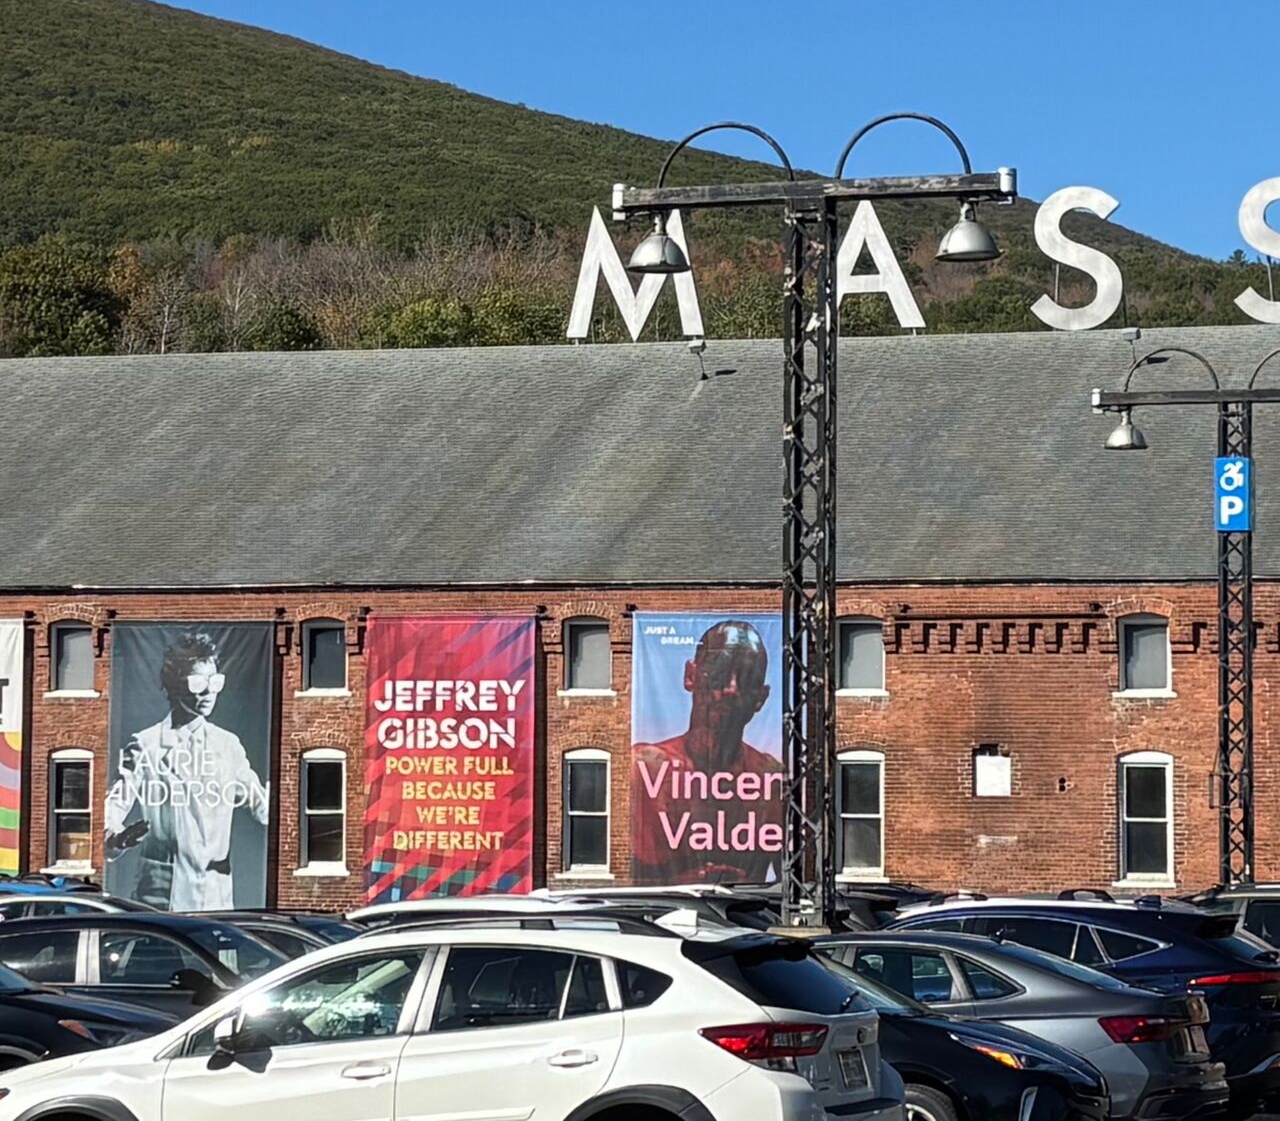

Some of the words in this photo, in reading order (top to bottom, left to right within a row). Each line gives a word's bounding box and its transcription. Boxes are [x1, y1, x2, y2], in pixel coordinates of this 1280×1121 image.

[1220, 495, 1244, 525] P
[669, 626, 677, 635] A
[374, 679, 527, 712] JEFFREY
[377, 717, 516, 750] GIBSON
[119, 748, 217, 777] LAURIE
[385, 755, 459, 776] POWER
[463, 756, 514, 776] FULL
[106, 780, 271, 808] ANDERSON
[401, 781, 496, 800] BECAUSE
[637, 759, 792, 801] Vincen
[416, 805, 480, 825] WE'RE
[393, 830, 505, 851] DIFFERENT
[658, 810, 793, 852] Valde
